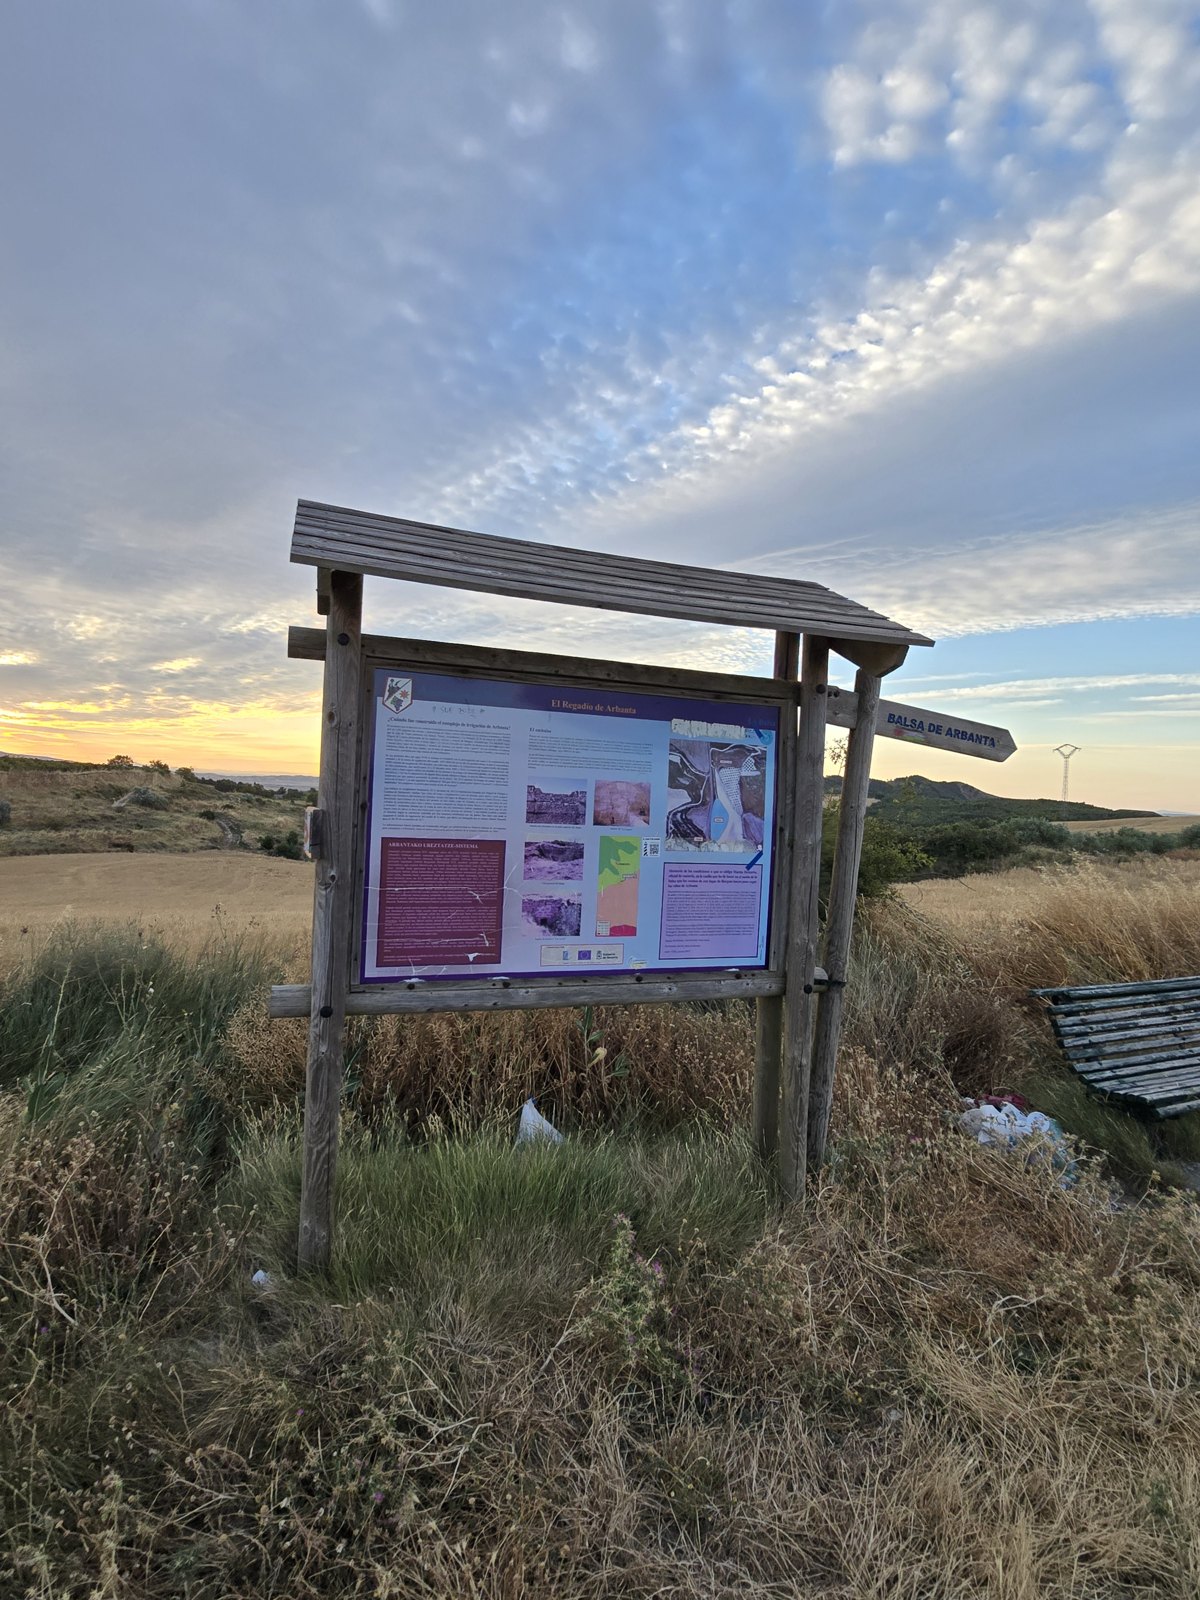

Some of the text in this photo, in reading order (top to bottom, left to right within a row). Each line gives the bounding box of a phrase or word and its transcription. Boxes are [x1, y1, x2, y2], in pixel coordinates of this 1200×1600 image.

[551, 699, 560, 708] El
[595, 704, 604, 712] de
[605, 704, 636, 714] Arbanta
[887, 712, 996, 748] BALSA DE ARBANTA
